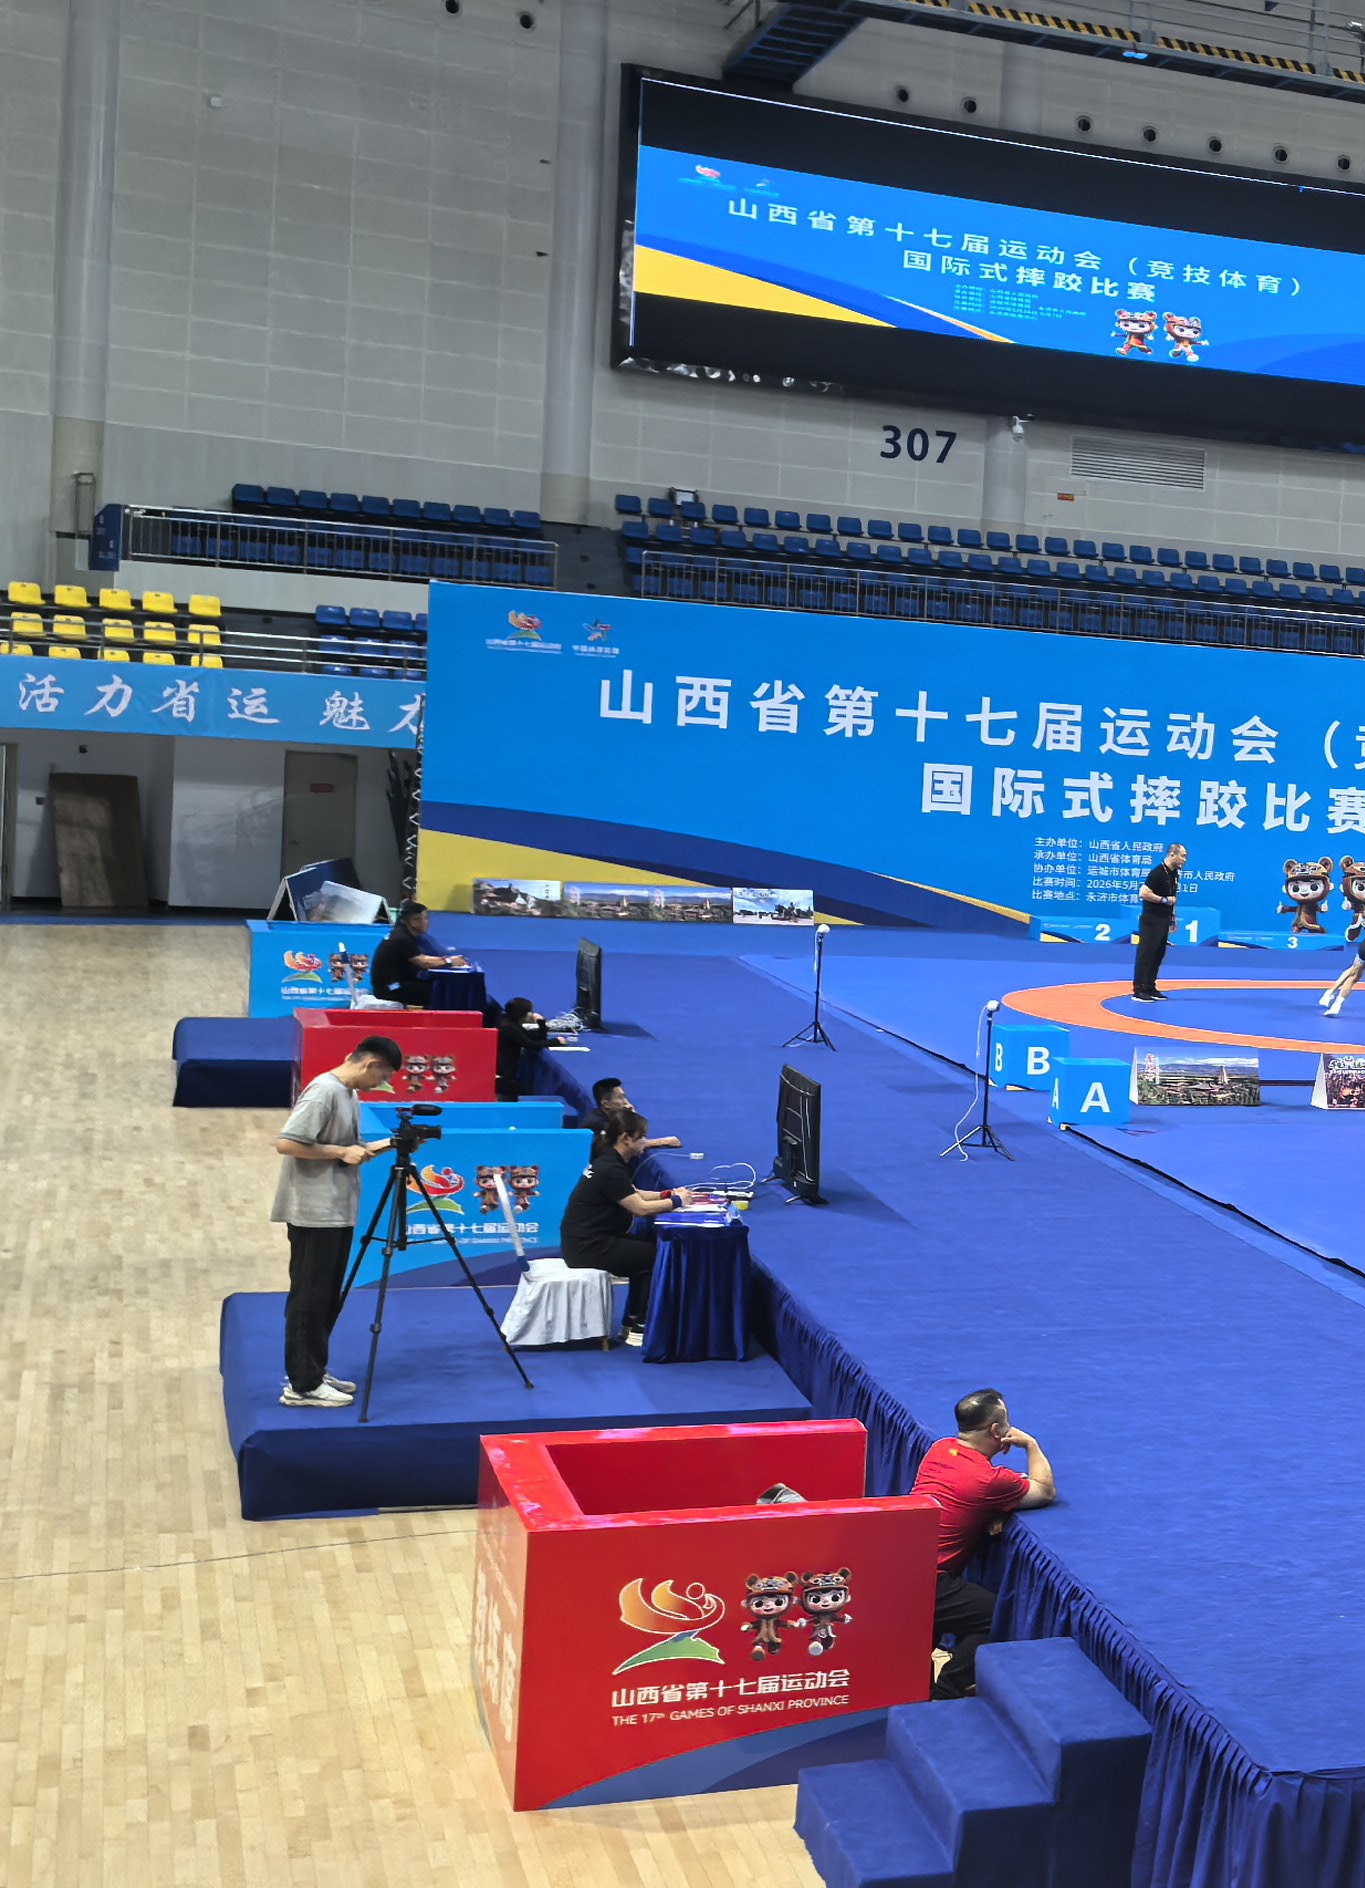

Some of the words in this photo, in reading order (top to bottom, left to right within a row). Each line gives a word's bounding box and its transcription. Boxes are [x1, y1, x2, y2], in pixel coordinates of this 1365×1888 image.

[728, 197, 1304, 298] 山西省第十七届运动会（竞技体育）
[903, 249, 1157, 302] 国际式摔跤比赛
[880, 425, 957, 464] 307
[18, 672, 280, 726] 活力省运
[1094, 924, 1111, 941] 2
[1185, 920, 1198, 942] 1
[1287, 937, 1298, 949] 3
[994, 1042, 1003, 1072] B
[1026, 1046, 1050, 1075] B
[1052, 1077, 1059, 1110] A
[1080, 1082, 1111, 1113] A
[612, 1669, 850, 1708] 山西省第十七届运动会
[612, 1715, 638, 1728] THE
[670, 1708, 714, 1722] GAMES
[718, 1706, 735, 1718] OF
[737, 1701, 784, 1715] SHANXI
[787, 1694, 850, 1711] PROVINCE
